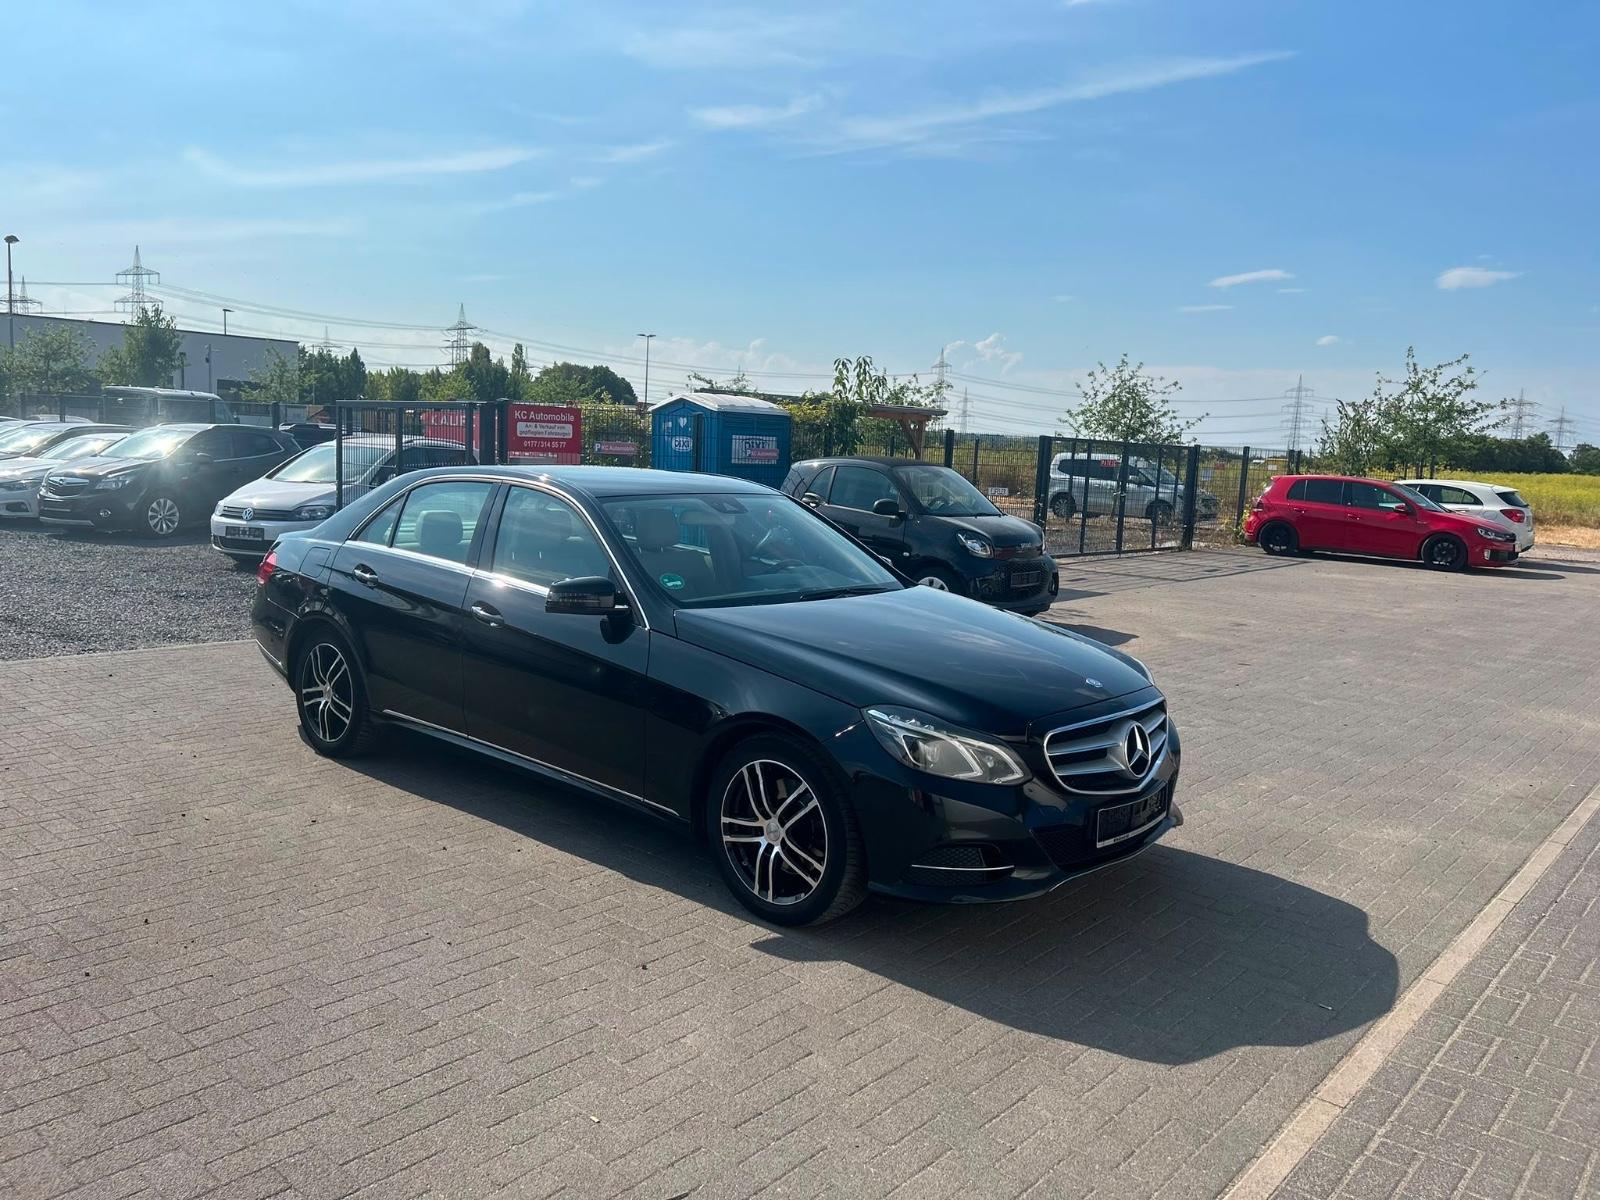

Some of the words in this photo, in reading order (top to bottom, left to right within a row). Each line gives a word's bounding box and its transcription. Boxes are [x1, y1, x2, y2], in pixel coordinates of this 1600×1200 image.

[514, 410, 527, 420] KC
[529, 411, 575, 422] Automobile
[523, 440, 550, 449] 0177/314
[595, 443, 600, 452] P
